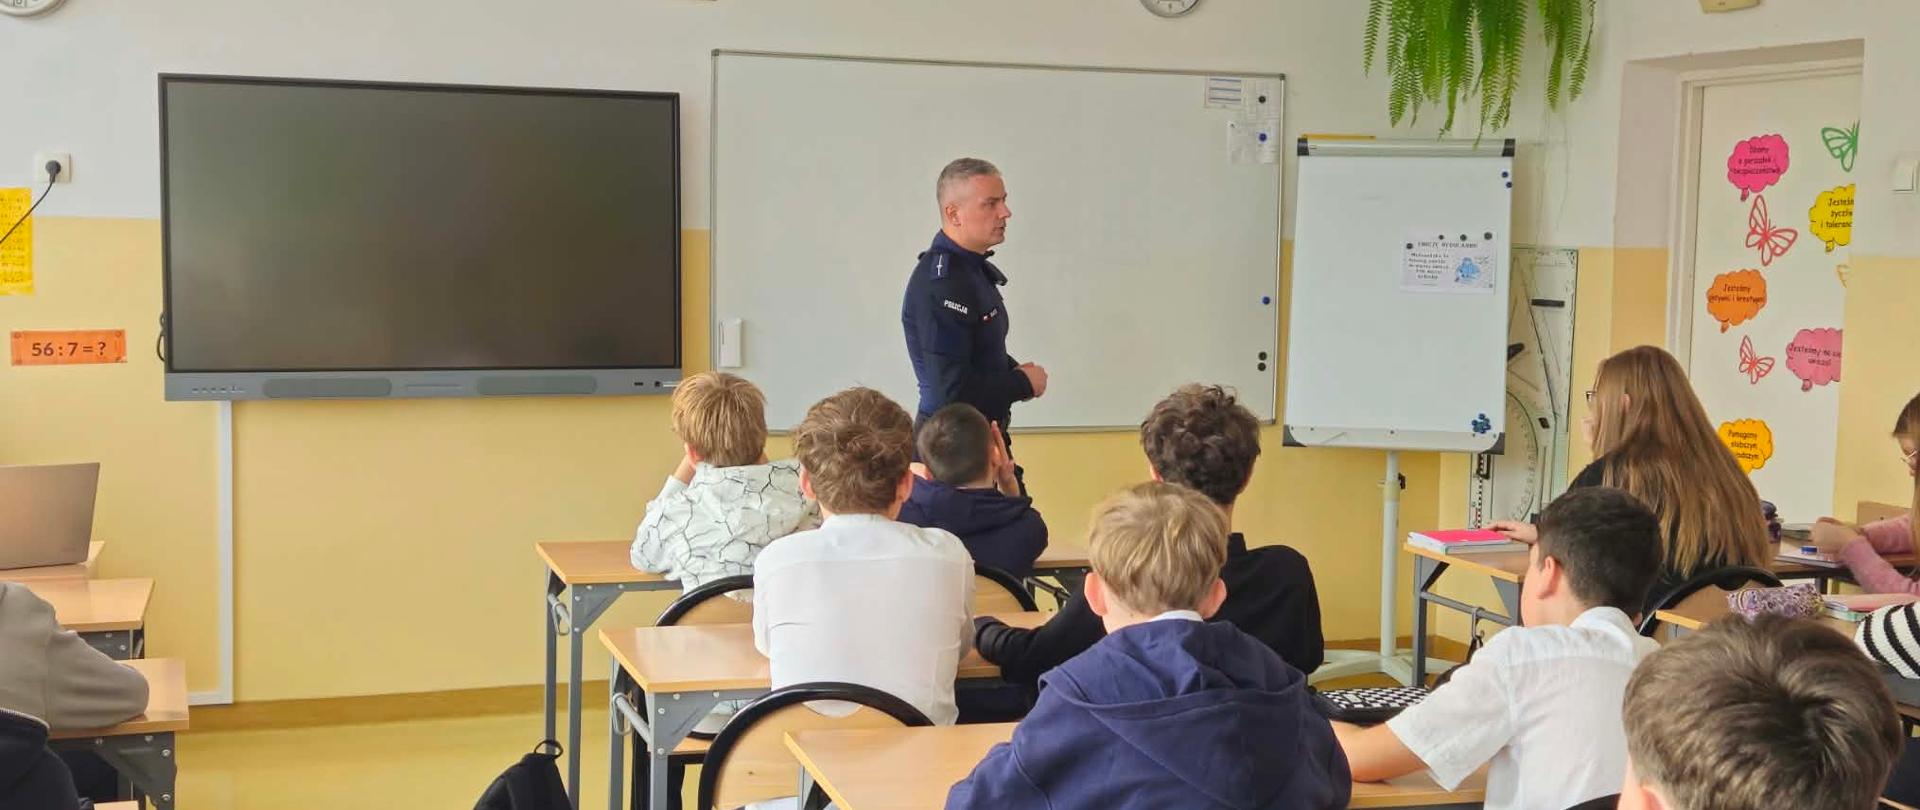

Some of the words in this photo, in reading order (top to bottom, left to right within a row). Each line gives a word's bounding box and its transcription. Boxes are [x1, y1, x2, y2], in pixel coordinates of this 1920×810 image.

[944, 299, 968, 315] POLICJA
[31, 342, 55, 357] 56
[67, 342, 79, 356] 7
